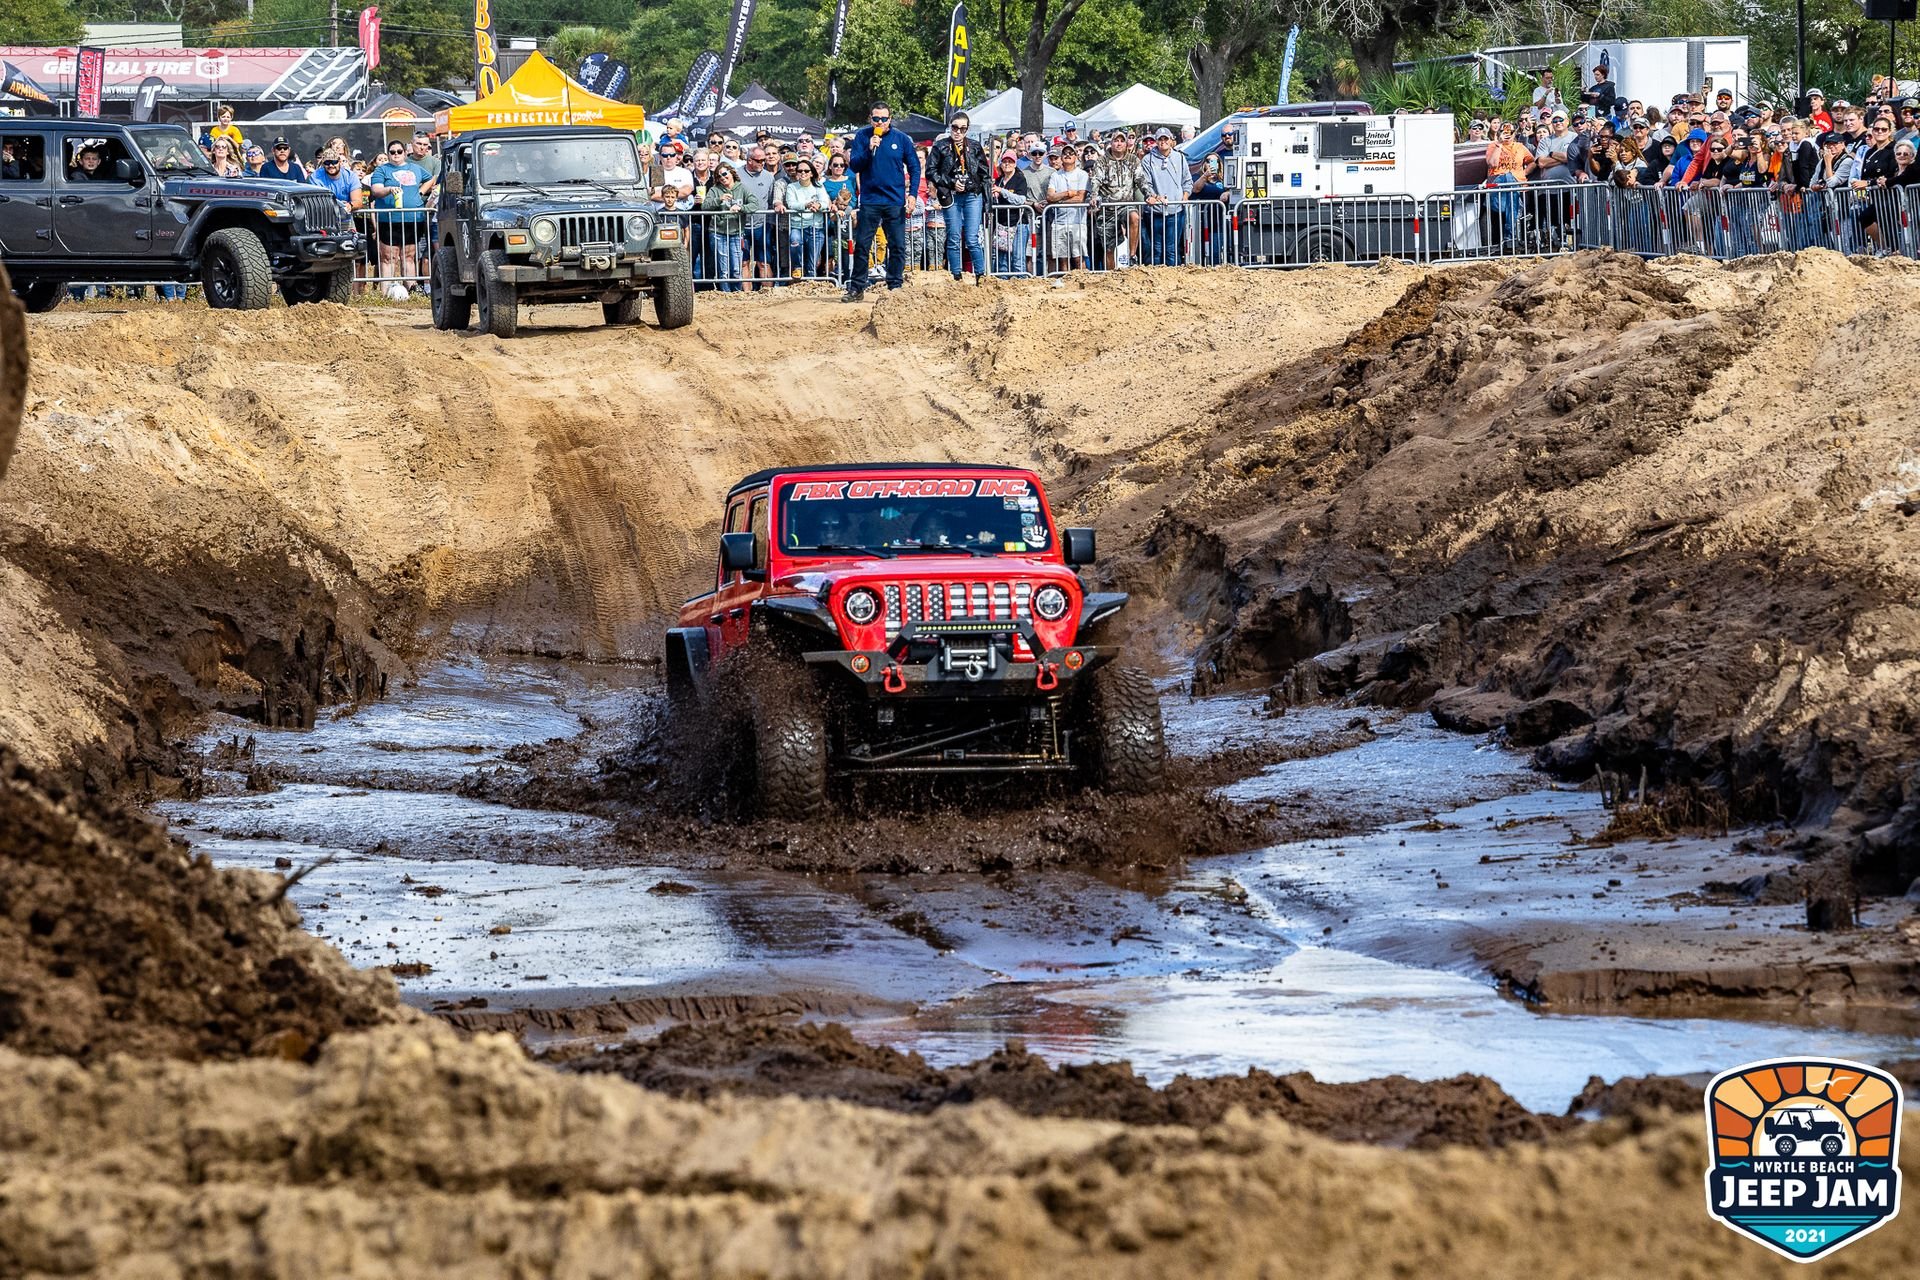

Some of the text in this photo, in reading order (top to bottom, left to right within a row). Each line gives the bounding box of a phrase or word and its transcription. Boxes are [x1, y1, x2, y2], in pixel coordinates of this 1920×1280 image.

[42, 61, 194, 75] GERAL TIRE
[487, 112, 559, 124] PERFECTLY
[1342, 152, 1396, 160] ERAC
[188, 188, 268, 197] RUBICON
[155, 229, 175, 237] Jeep
[791, 482, 848, 500] FBK
[977, 479, 1030, 497] INC.
